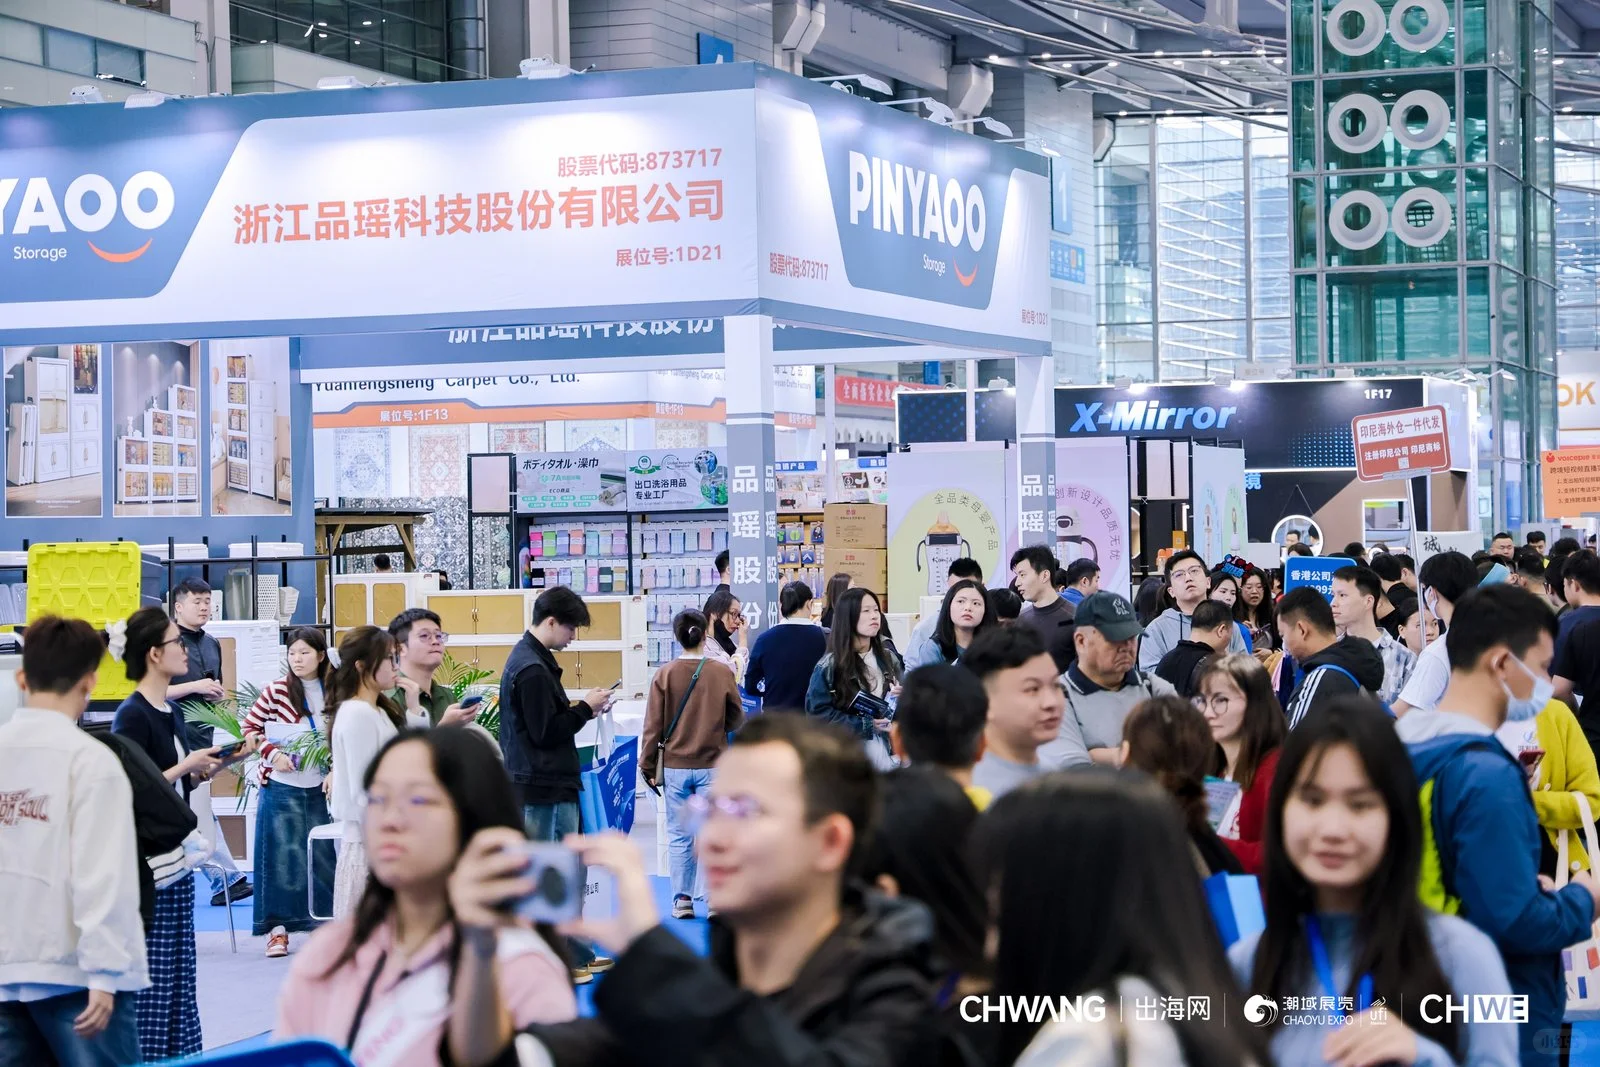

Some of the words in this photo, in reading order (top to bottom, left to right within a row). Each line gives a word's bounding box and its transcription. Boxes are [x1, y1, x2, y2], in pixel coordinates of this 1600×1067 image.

[558, 148, 722, 177] 股票代码:873717
[233, 179, 724, 245] 浙江品瑶科技股份有限公司
[848, 150, 986, 252] PINYAOO
[13, 245, 67, 261] Storage
[615, 245, 722, 267] 展位号:1D21
[769, 252, 829, 281] 股票代码:873717
[923, 254, 946, 276] Storage
[1021, 308, 1048, 326] 展位号:1D21
[1364, 388, 1392, 399] 1F17
[380, 409, 448, 422] 展位号:1F13
[1069, 400, 1237, 432] X-Mirror
[1360, 415, 1440, 438] 印尼海外仓一件代发
[1364, 446, 1409, 460] 注册印尼公司
[1411, 442, 1441, 454] 印尼商标
[634, 478, 687, 489] 出口洗浴用品
[635, 490, 670, 501] 专业工厂
[934, 492, 998, 551] 全品类母婴产品
